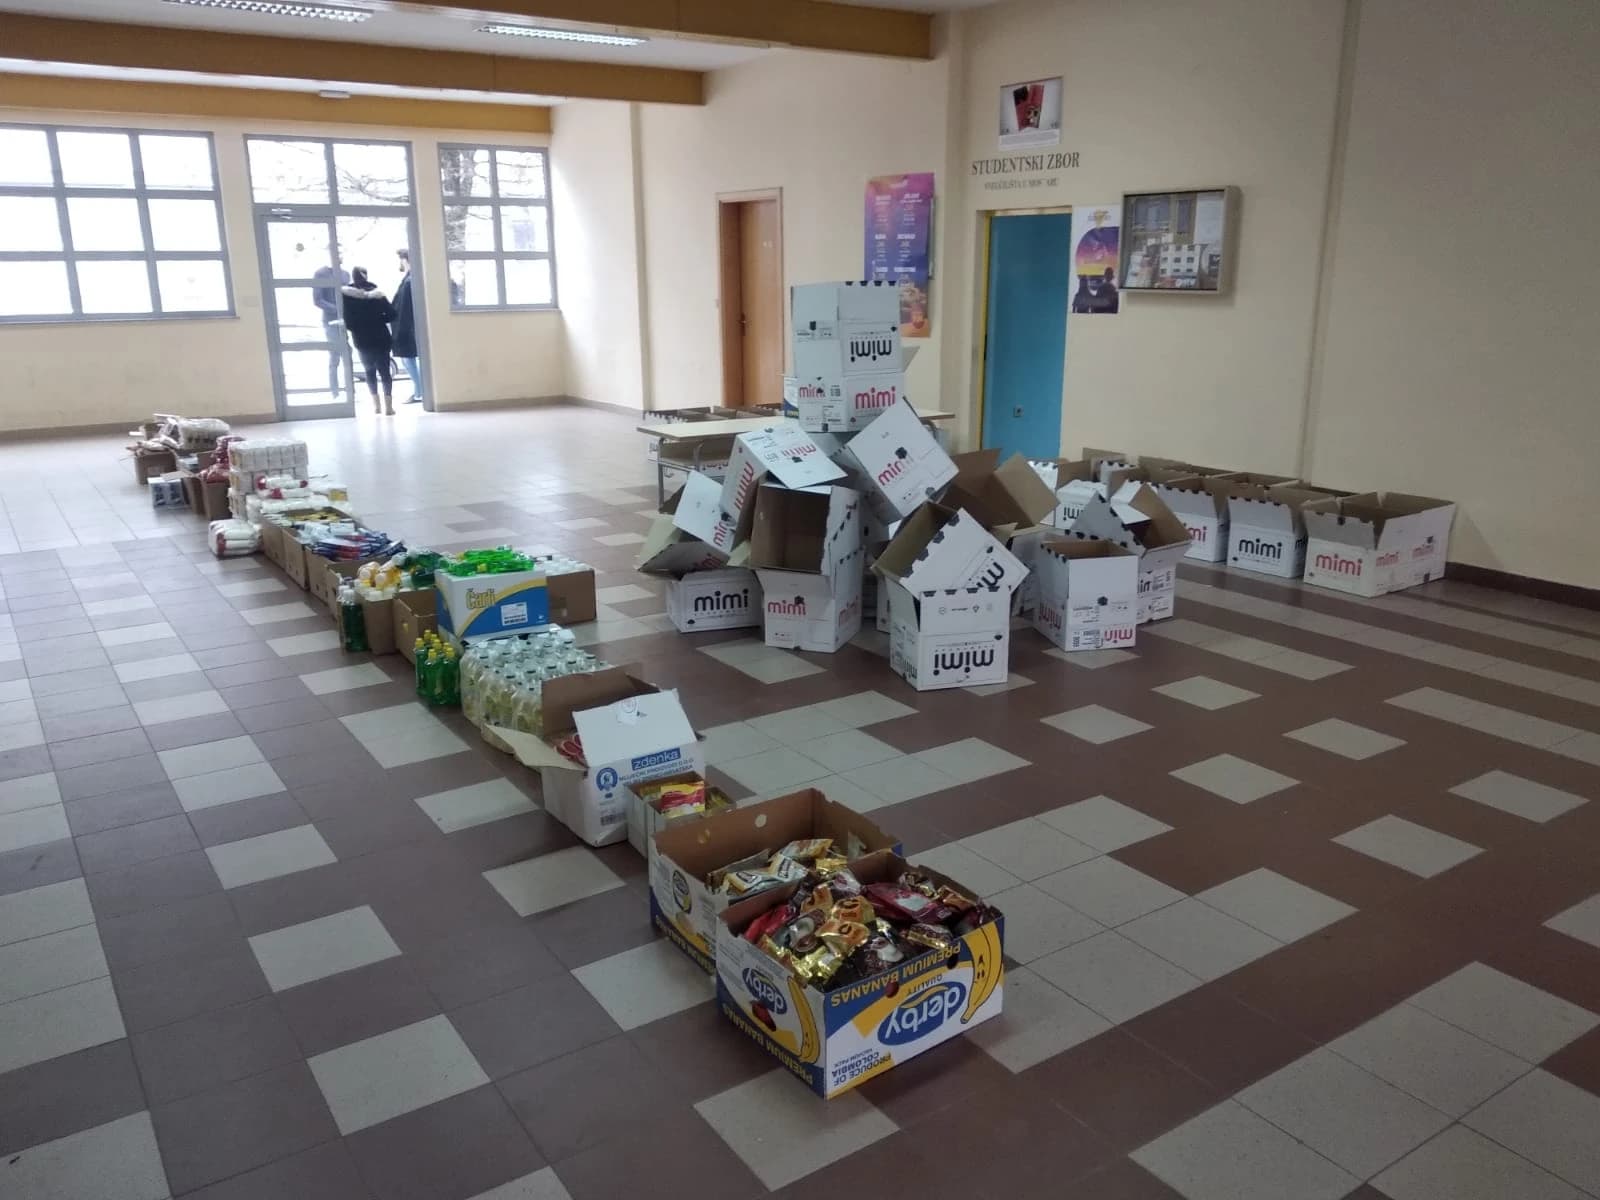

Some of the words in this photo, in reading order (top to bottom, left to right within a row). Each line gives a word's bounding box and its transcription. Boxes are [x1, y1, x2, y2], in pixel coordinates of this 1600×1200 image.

[971, 155, 1044, 175] STUDENTSKI
[1047, 152, 1080, 170] ZBOR
[850, 340, 892, 362] mimi
[855, 386, 896, 410] mimi
[1239, 538, 1282, 559] mimi
[1375, 551, 1400, 567] mimi
[1315, 553, 1363, 576] mimi
[694, 588, 749, 612] mimi
[768, 599, 806, 615] mimi
[933, 649, 994, 676] mimi
[632, 751, 679, 769] zdenka
[903, 942, 961, 978] PREMIUM
[743, 970, 784, 1013] derby
[831, 971, 899, 1007] BANANAS
[908, 974, 942, 994] QUALITY
[885, 986, 960, 1039] derby
[766, 1040, 813, 1085] PREMIUM
[832, 1051, 879, 1077] COLOMBIA
[849, 1052, 891, 1078] PRODUCE
[834, 1074, 847, 1086] OF
